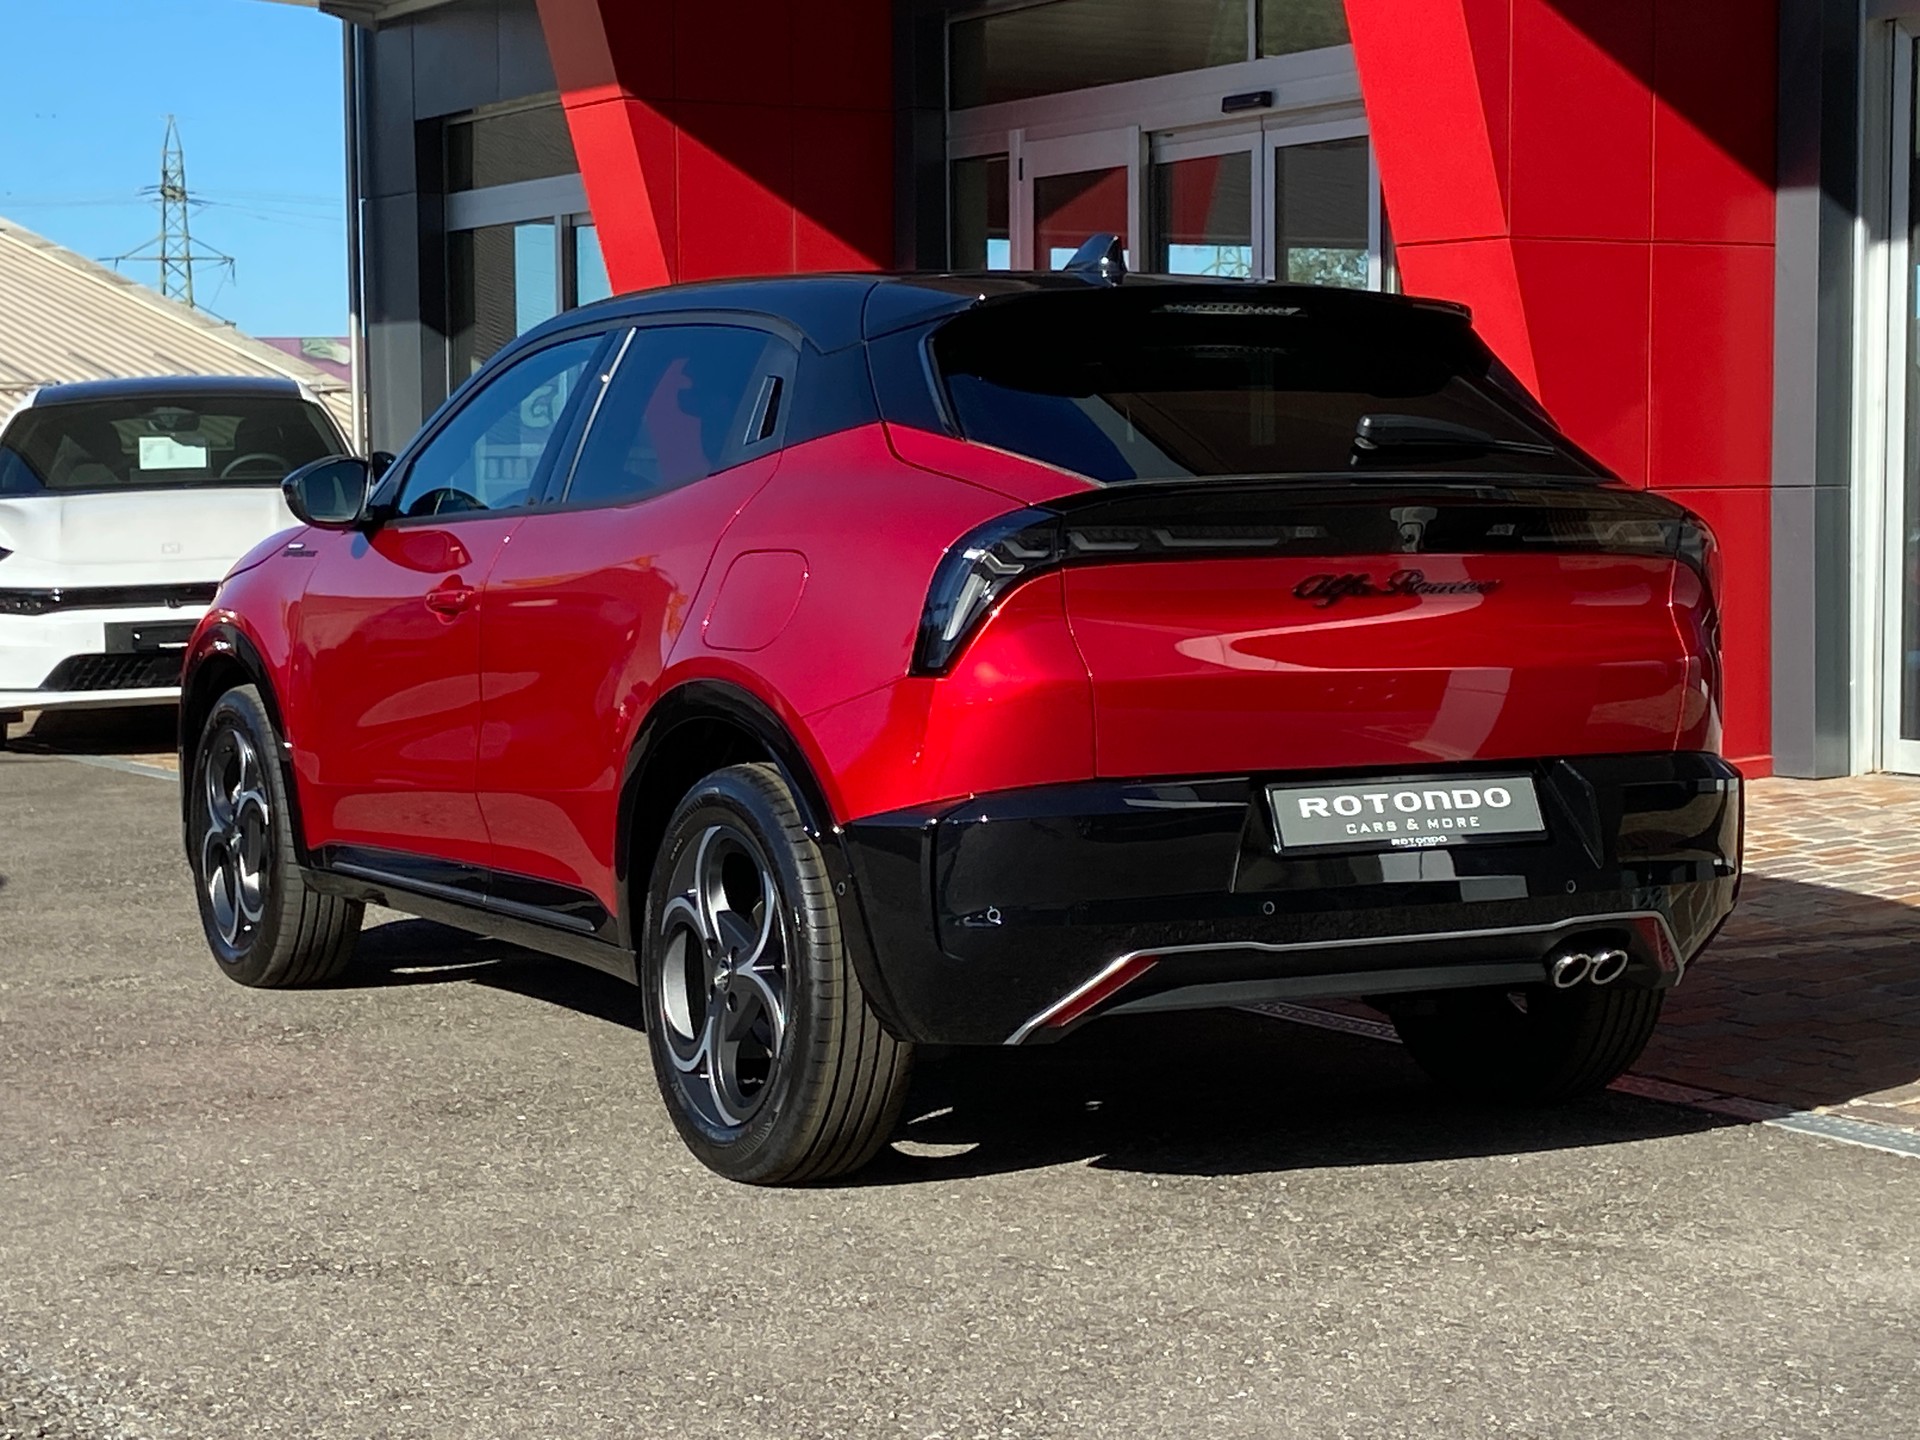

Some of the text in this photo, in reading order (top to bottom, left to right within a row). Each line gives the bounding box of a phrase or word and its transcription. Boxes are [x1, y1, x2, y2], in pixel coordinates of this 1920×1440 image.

[1298, 787, 1512, 819] ROTONDO
[1346, 816, 1480, 835] CARS & MORE
